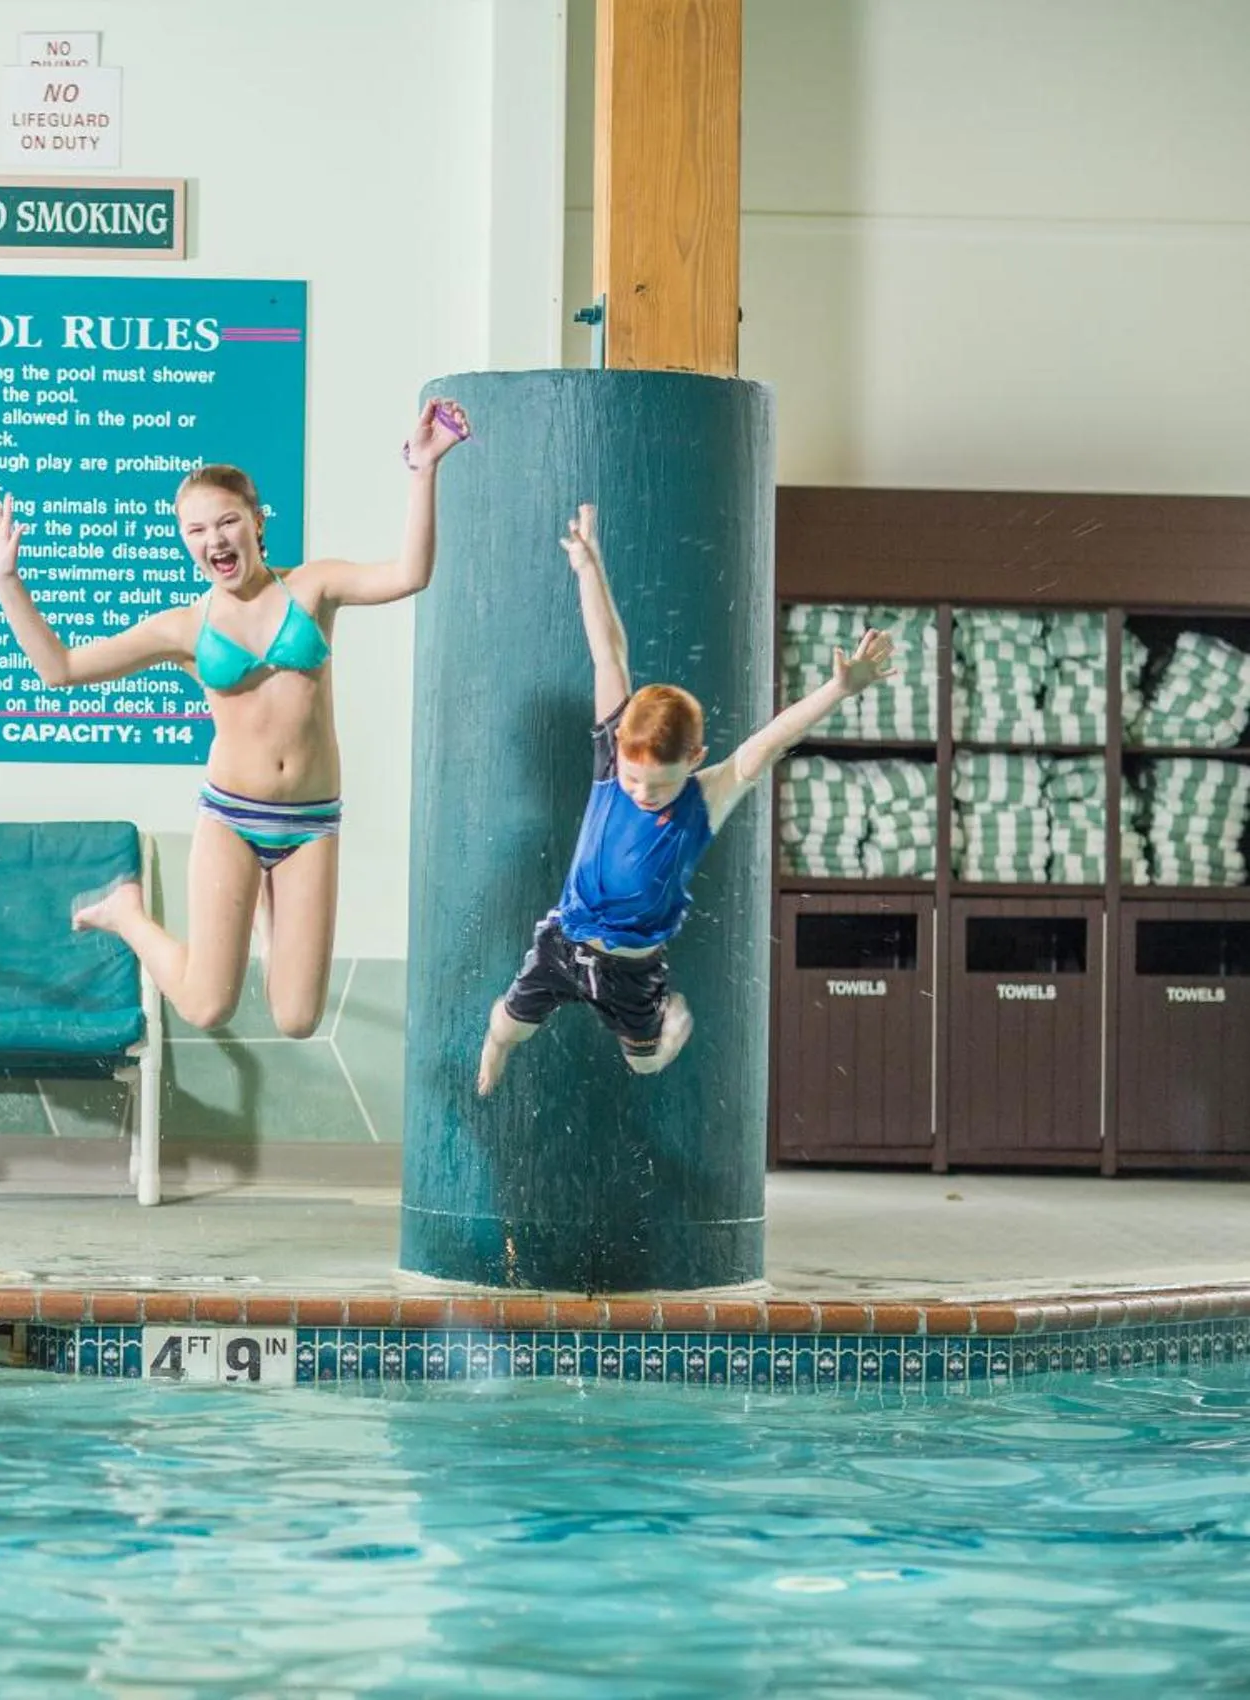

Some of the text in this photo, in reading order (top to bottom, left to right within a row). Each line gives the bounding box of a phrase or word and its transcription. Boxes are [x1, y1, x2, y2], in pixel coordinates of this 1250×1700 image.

[46, 41, 71, 56] NO
[43, 83, 80, 103] NO
[12, 113, 110, 128] LIFEGUARD
[21, 135, 100, 151] ON DUTY
[16, 201, 168, 235] SMOKING
[61, 315, 220, 352] RULES
[22, 364, 50, 380] the
[57, 365, 96, 384] pool
[103, 367, 146, 383] must
[153, 366, 216, 383] shower
[3, 388, 30, 402] the
[36, 387, 78, 405] pool.
[2, 409, 68, 426] allowed
[75, 410, 91, 426] in
[97, 410, 125, 426] the
[133, 411, 171, 430] pool
[178, 414, 197, 428] or
[36, 453, 72, 473] play
[79, 457, 108, 471] are
[115, 455, 203, 474] prohibited
[43, 498, 107, 515] animals
[115, 499, 147, 516] into
[45, 520, 72, 536] the
[80, 521, 117, 539] pool
[124, 521, 136, 538] if
[144, 524, 176, 540] you
[18, 541, 104, 559] municable
[112, 544, 184, 560] disease.
[18, 564, 135, 582] on-swimmers
[142, 566, 186, 583] must
[31, 588, 86, 603] parent
[93, 591, 111, 604] or
[120, 588, 162, 604] adult
[40, 612, 94, 626] erves
[102, 609, 130, 626] the
[83, 677, 184, 695] regulations.
[5, 698, 27, 712] on
[35, 695, 61, 712] the
[69, 696, 106, 716] pool
[113, 697, 155, 713] deck
[162, 697, 176, 713] is
[2, 723, 142, 743] CAPACITY:
[153, 725, 194, 744] 114
[827, 980, 887, 996] TOWELS
[997, 984, 1056, 1000] TOWELS
[1166, 986, 1225, 1002] TOWELS
